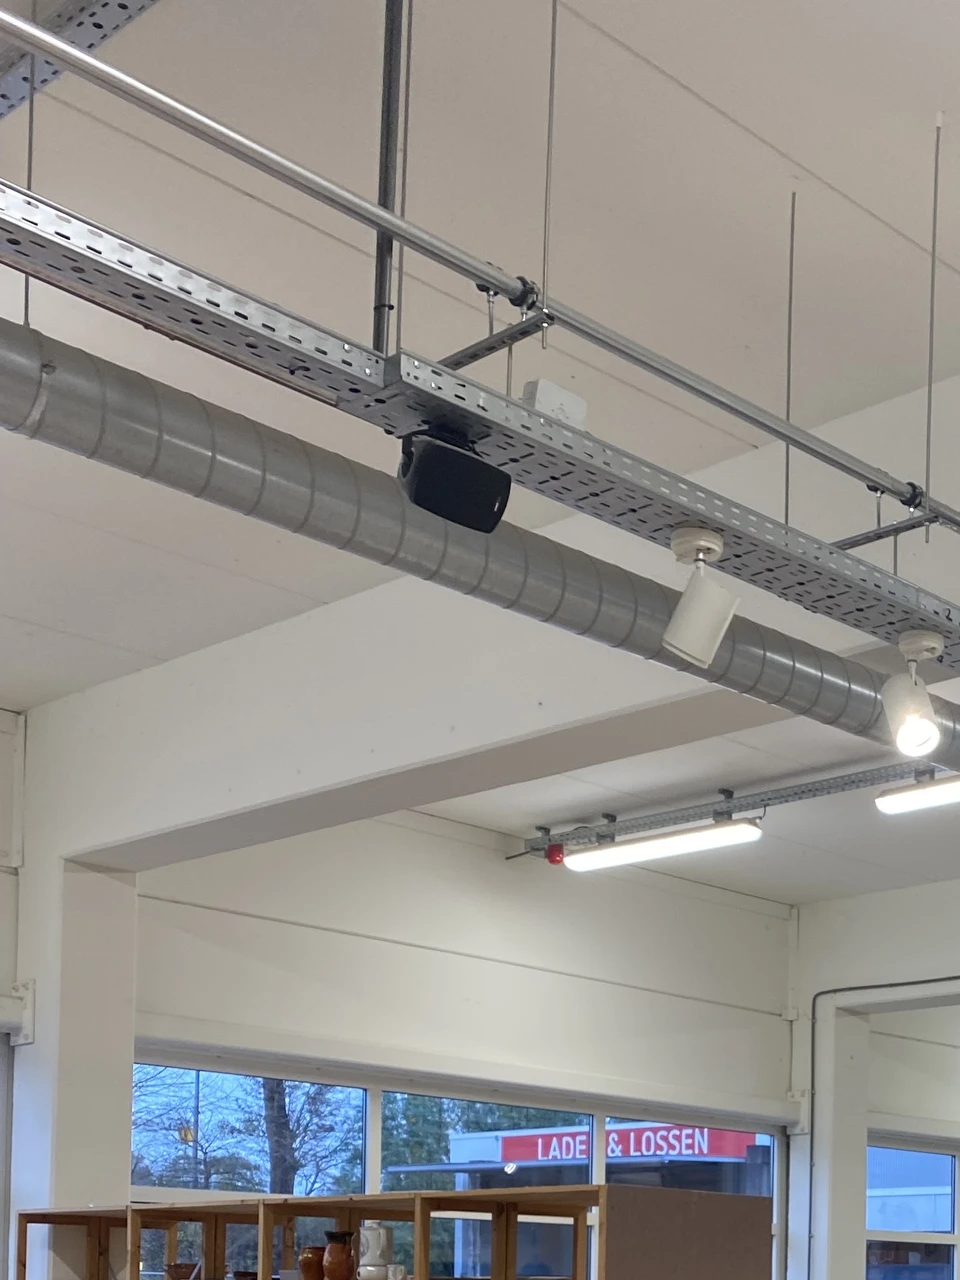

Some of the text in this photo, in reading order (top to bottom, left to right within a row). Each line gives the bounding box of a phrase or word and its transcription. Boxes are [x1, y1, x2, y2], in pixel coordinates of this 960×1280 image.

[537, 1127, 709, 1161] LADE & LOSSEN
